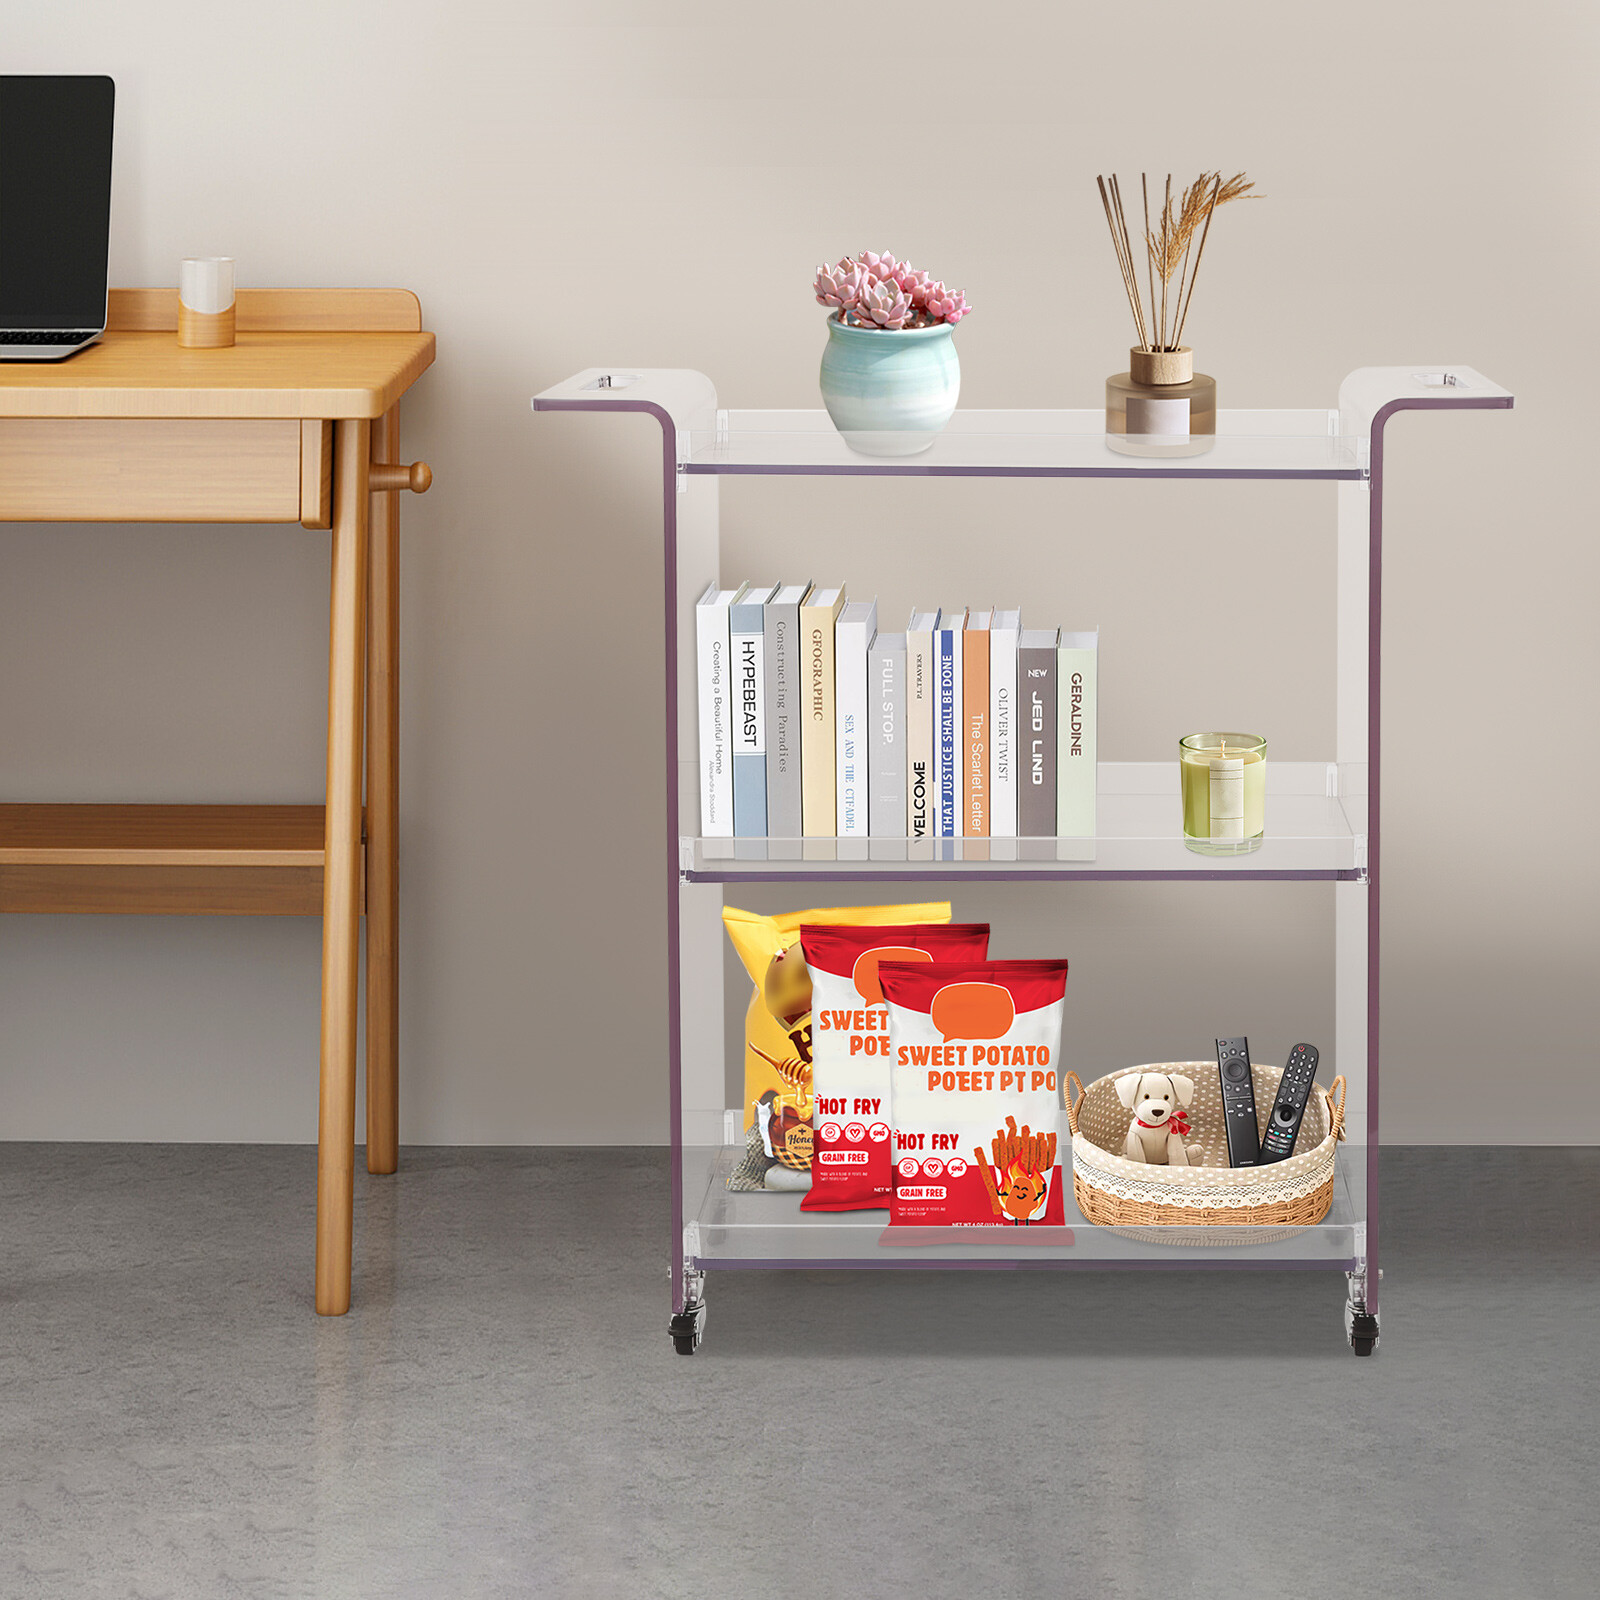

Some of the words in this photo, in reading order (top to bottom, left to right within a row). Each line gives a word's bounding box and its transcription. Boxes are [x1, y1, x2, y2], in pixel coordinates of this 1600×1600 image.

[712, 641, 722, 685] Creating
[776, 621, 788, 709] Constructing
[882, 658, 894, 698] FULL
[943, 654, 953, 687] DONE
[1027, 669, 1048, 678] NEW
[742, 641, 757, 747] HYPEBEAST
[943, 689, 953, 704] BE
[1032, 691, 1043, 732] JED
[714, 697, 724, 742] Beautiful
[845, 714, 855, 734] SEX
[882, 701, 894, 745] STOP.
[943, 706, 953, 743] SHALL
[971, 713, 983, 739] The
[998, 688, 1009, 737] OLIVER
[1070, 672, 1082, 757] GERALDINE
[715, 744, 724, 775] Home
[778, 715, 789, 773] Paradies
[845, 739, 855, 759] AND
[998, 739, 1009, 782] TWIST
[845, 764, 855, 783] THE
[943, 746, 953, 796] JUSTICE
[971, 742, 984, 790] Scarlet
[1032, 740, 1043, 785] LIND
[943, 800, 953, 832] THAT
[971, 793, 984, 832] Letter
[819, 1009, 889, 1031] SWEET
[897, 1045, 967, 1066] SWEET
[972, 1045, 1050, 1066] POTATO
[1000, 1070, 1026, 1093] PT
[819, 1098, 847, 1115] HOT
[854, 1098, 882, 1115] FRY
[821, 1153, 845, 1162] GRAIN
[847, 1153, 866, 1162] FREE
[897, 1133, 925, 1150] HOT
[931, 1133, 959, 1150] FRY
[900, 1188, 923, 1197] GRAIN
[925, 1188, 944, 1197] FREE
